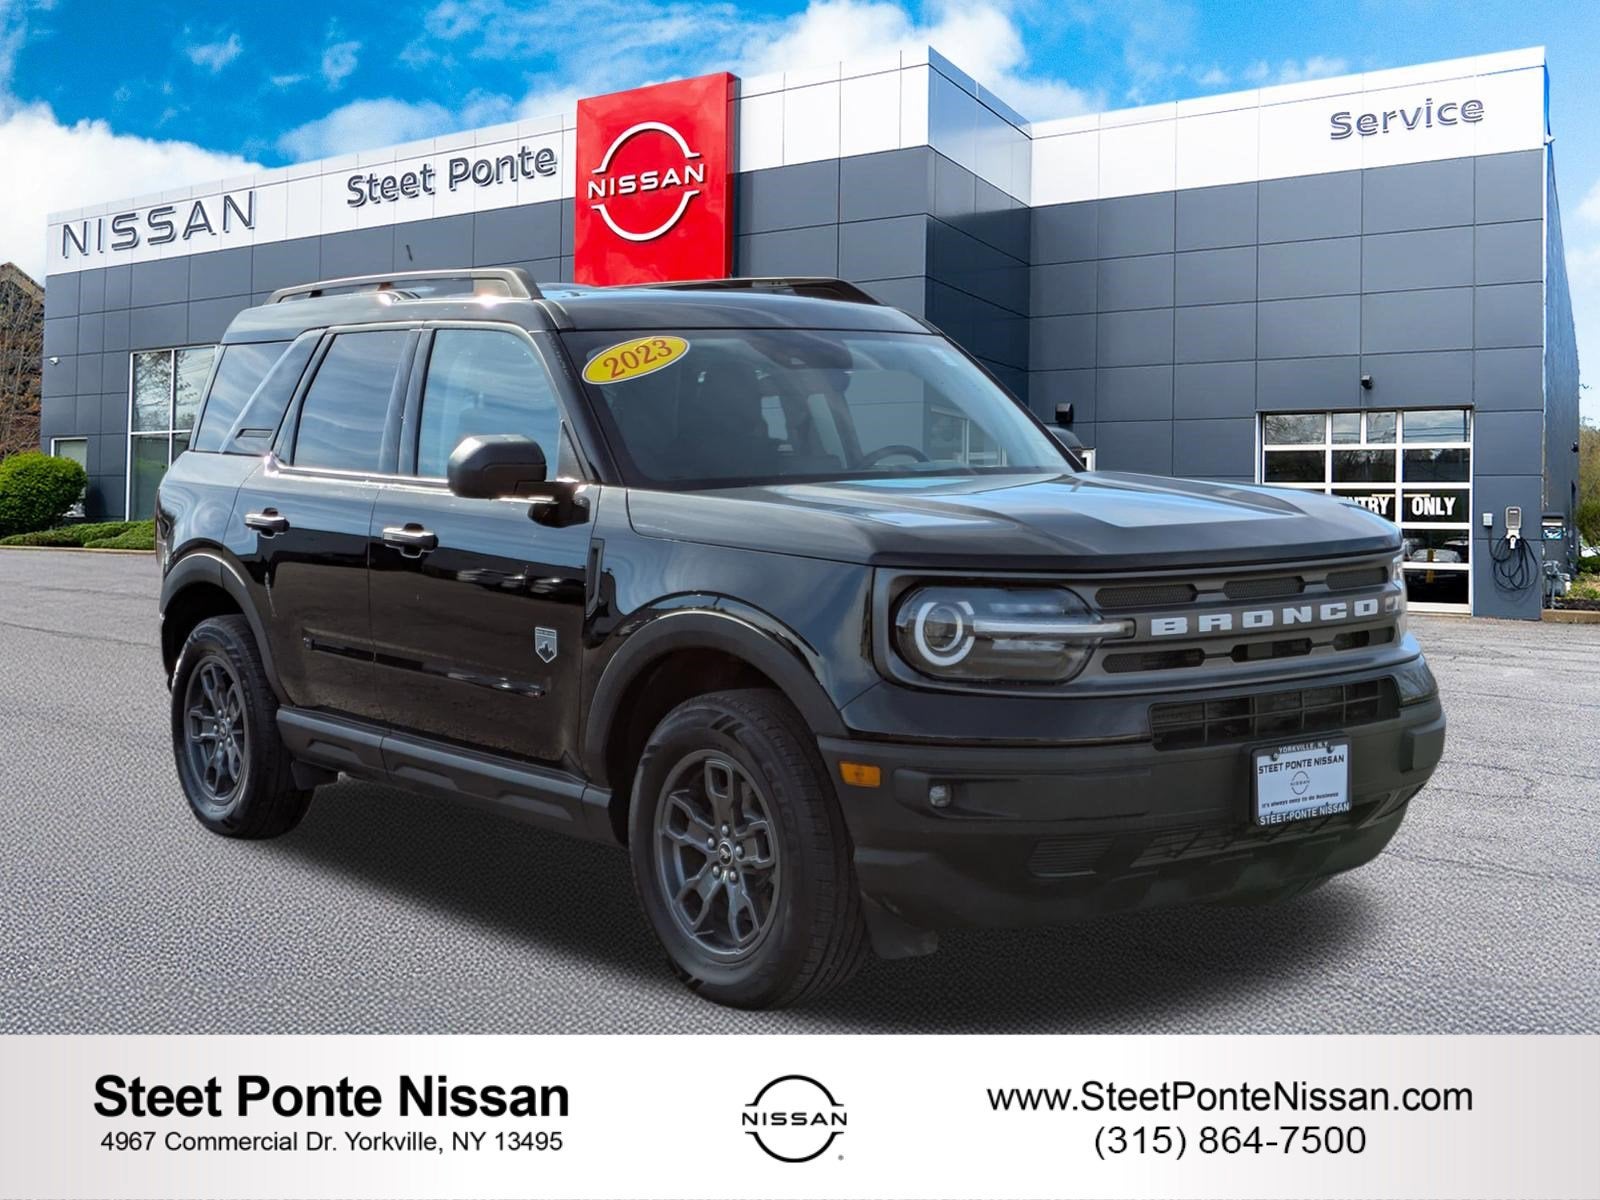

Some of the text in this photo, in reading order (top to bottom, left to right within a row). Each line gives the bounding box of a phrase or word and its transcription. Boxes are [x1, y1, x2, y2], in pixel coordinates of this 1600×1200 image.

[1330, 97, 1485, 140] Service
[347, 146, 558, 208] Steet Ponte
[587, 163, 705, 200] NISSAN
[62, 190, 255, 259] NISSAN
[603, 339, 673, 379] 2023
[1411, 496, 1457, 516] ONLY
[1151, 599, 1378, 636] BRONCO
[1258, 754, 1345, 775] STEET PONTE NISSAN
[1320, 801, 1350, 816] NISSAN
